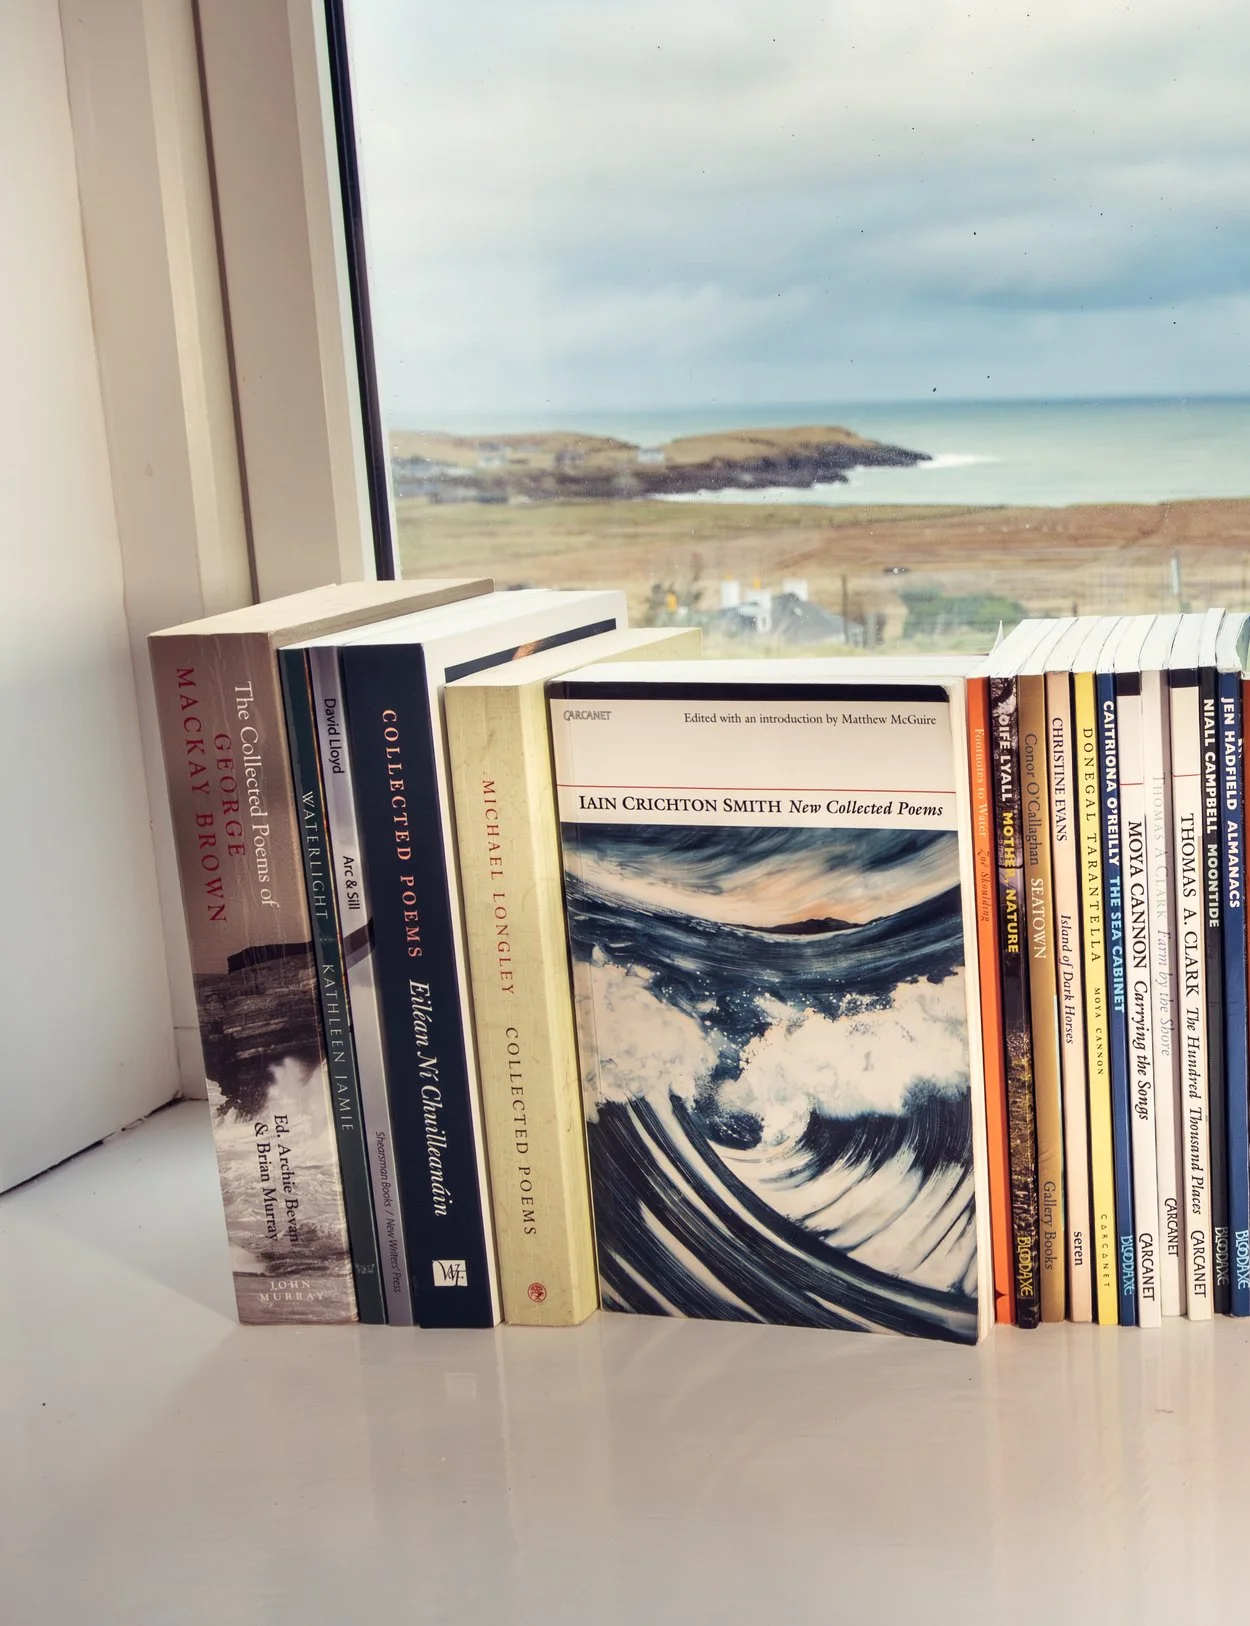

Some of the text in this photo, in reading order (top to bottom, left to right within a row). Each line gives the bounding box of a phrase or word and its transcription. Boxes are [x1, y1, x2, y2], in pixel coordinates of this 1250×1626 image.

[323, 698, 345, 775] David Lloyd
[563, 709, 612, 721] CARCANET
[684, 712, 937, 726] Edited with an introduction by Matthew McGuire
[1024, 733, 1038, 777] Conor
[1103, 700, 1117, 793] CAITRIONA
[1204, 699, 1218, 834] NIALL CAMPBELL
[1221, 697, 1238, 811] JEN HADFIELD
[176, 667, 227, 922] MACKAY BROWN
[214, 734, 246, 857] GEORGE
[234, 681, 279, 909] The Collected Poems of
[382, 709, 423, 957] COLLECTED POEMS
[578, 795, 943, 817] IAIN CRICHTON SMITH New Collected Poems
[1000, 755, 1012, 802] LYALL
[1052, 717, 1068, 842] CHRISTINE EVANS
[302, 790, 328, 919] WATERLIGHT
[342, 855, 361, 910] Arc & Sill
[482, 780, 516, 996] MICHAEL LONGLEY
[1083, 728, 1101, 962] DONEGAL TARANTELLA
[1207, 844, 1220, 928] MOONTIDE
[1227, 820, 1240, 908] ALMANACS
[1006, 890, 1018, 953] NATURE
[1031, 878, 1047, 959] SEATOWN
[1109, 876, 1125, 1013] THE SEA CABINET
[1181, 813, 1200, 997] THOMAS CLARK
[1059, 914, 1076, 1044] Island of Dark Horses
[1128, 821, 1152, 1121] MOYA CANNON Carrying the Songs
[1155, 971, 1175, 1057] by the Shore
[322, 964, 354, 1131] KATHLEEN JAMIE
[1095, 1028, 1104, 1075] CANNON
[505, 1027, 537, 1235] COLLECTED POEMS
[1186, 1007, 1205, 1215] The Hundred Thousand Places
[254, 1122, 278, 1242] & Brian Murray
[274, 1114, 300, 1243] Ed. Archie Bevan
[1042, 1181, 1058, 1270] Gallery Books
[1016, 1236, 1033, 1297] BLOODAXE
[1073, 1231, 1083, 1266] seren
[1100, 1214, 1110, 1287] CARCANET
